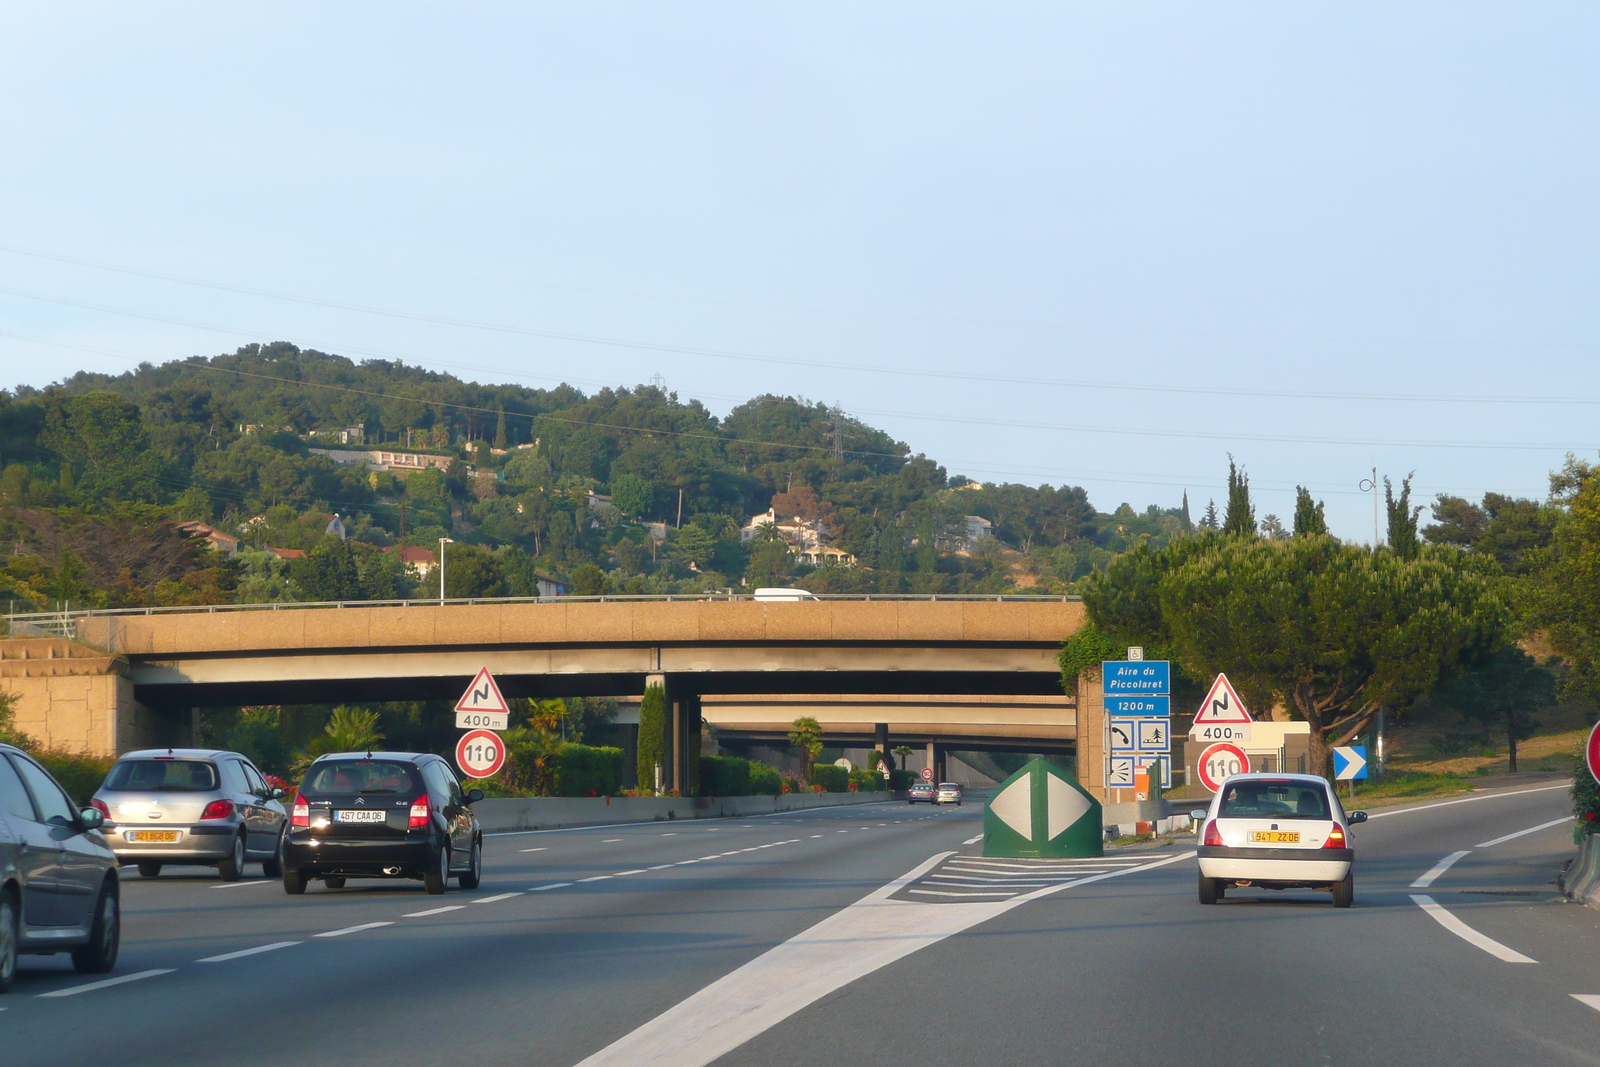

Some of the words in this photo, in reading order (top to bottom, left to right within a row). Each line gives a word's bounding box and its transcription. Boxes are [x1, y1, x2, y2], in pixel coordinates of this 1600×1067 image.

[1117, 667, 1138, 676] Aire
[1143, 667, 1155, 676] du
[1110, 680, 1163, 689] Piccolaret
[1118, 702, 1144, 711] 1200
[463, 715, 490, 727] 400
[492, 720, 501, 728] m
[1203, 727, 1232, 739] 400
[1234, 731, 1244, 739] m
[465, 745, 496, 762] 110
[1207, 759, 1241, 777] 110
[340, 811, 355, 820] 467
[356, 811, 371, 820] CAA
[372, 811, 382, 820] 06
[135, 832, 148, 840] 921
[165, 832, 175, 840] 06
[1256, 832, 1272, 841] 947
[1288, 833, 1299, 842] 06
